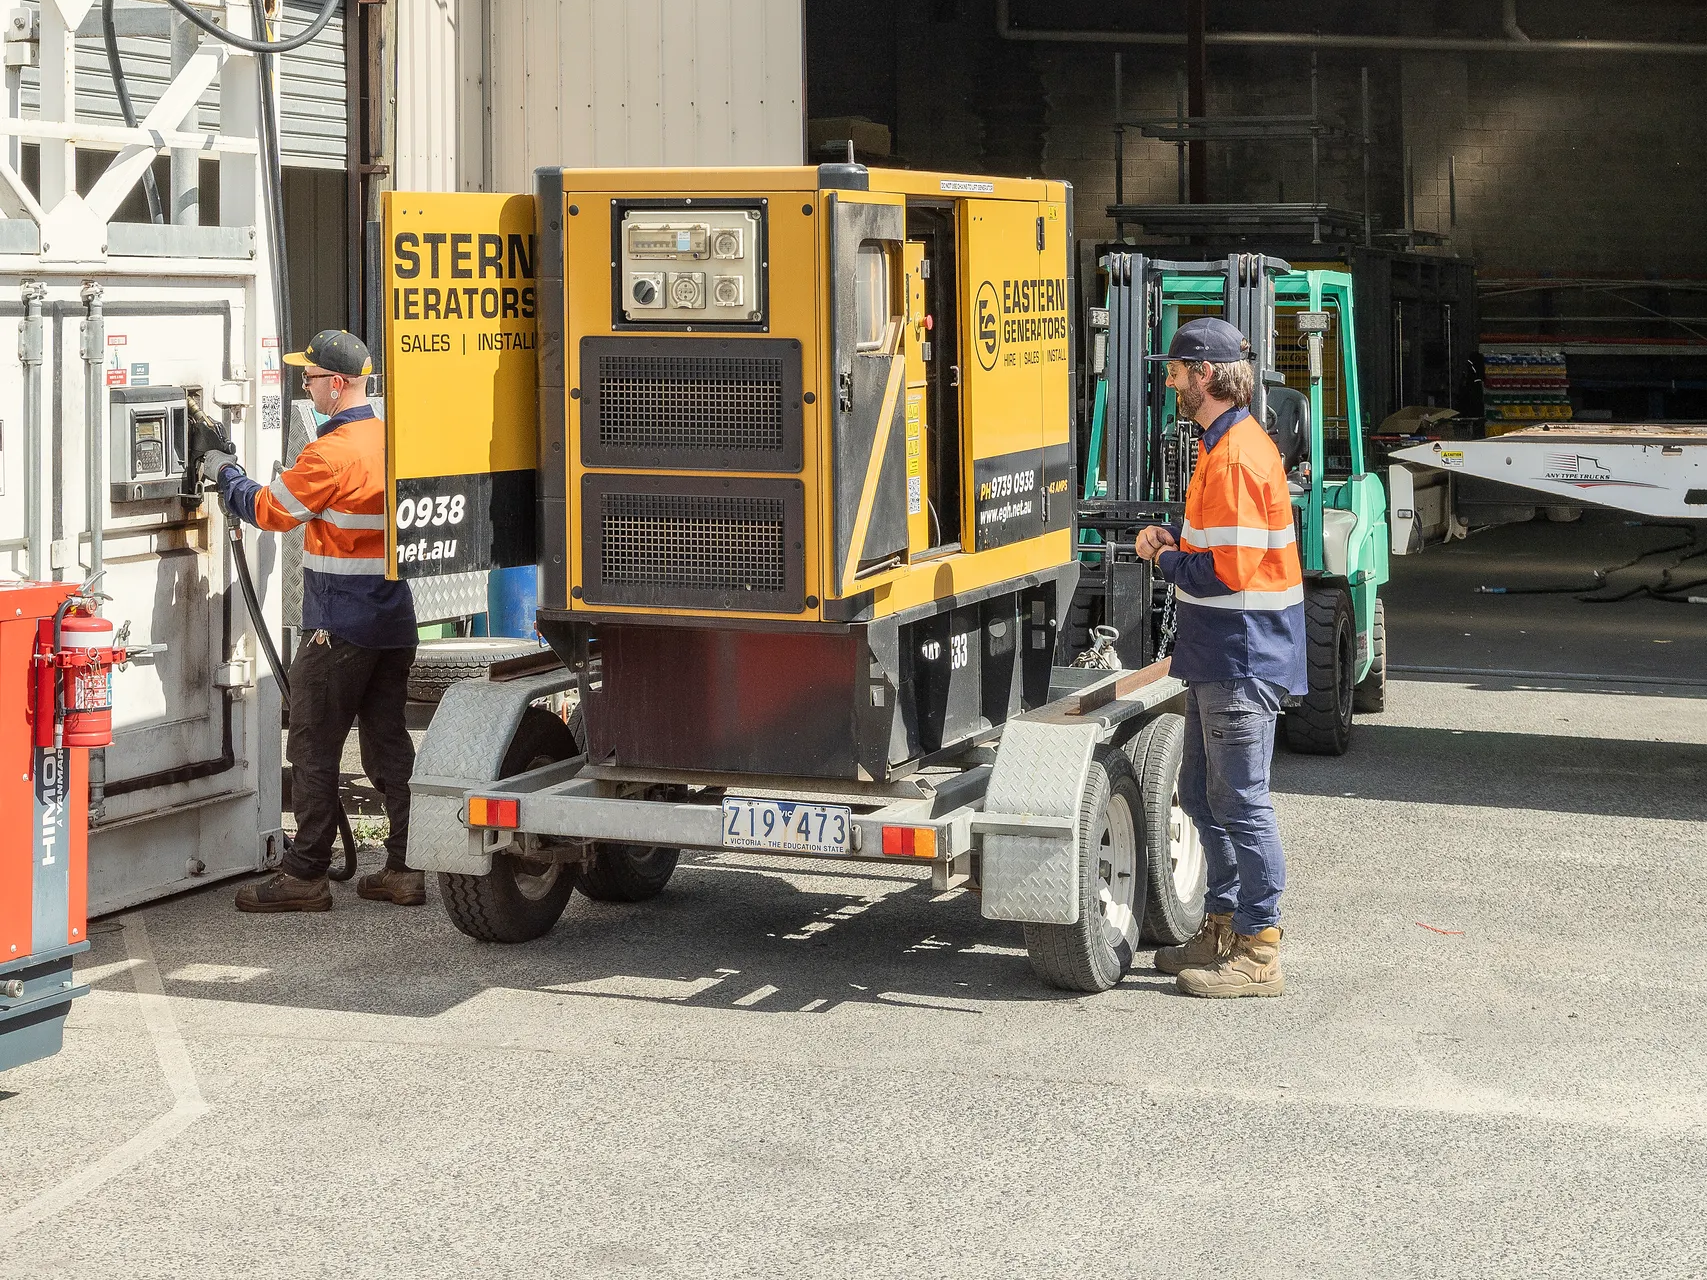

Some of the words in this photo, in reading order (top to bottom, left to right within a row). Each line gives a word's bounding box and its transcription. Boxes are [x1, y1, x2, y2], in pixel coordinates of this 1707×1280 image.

[394, 232, 535, 279] STERN
[1003, 279, 1065, 314] EASTERN
[401, 333, 451, 353] SALES
[1003, 316, 1066, 344] GENERATORS
[1003, 352, 1016, 367] HIRE
[1024, 350, 1040, 365] SALES
[1047, 348, 1067, 363] INSTALL
[980, 481, 992, 501] PH
[991, 474, 1013, 499] 9739
[1013, 469, 1035, 494] 0938
[396, 494, 466, 530] 0938
[980, 500, 1032, 525] www.egh.net.au
[56, 749, 64, 816] YANMAR
[781, 810, 793, 818] VIC
[730, 837, 762, 847] VICTORIA
[768, 840, 781, 848] THE
[783, 842, 821, 852] EDUCATION
[823, 845, 844, 853] STATE
